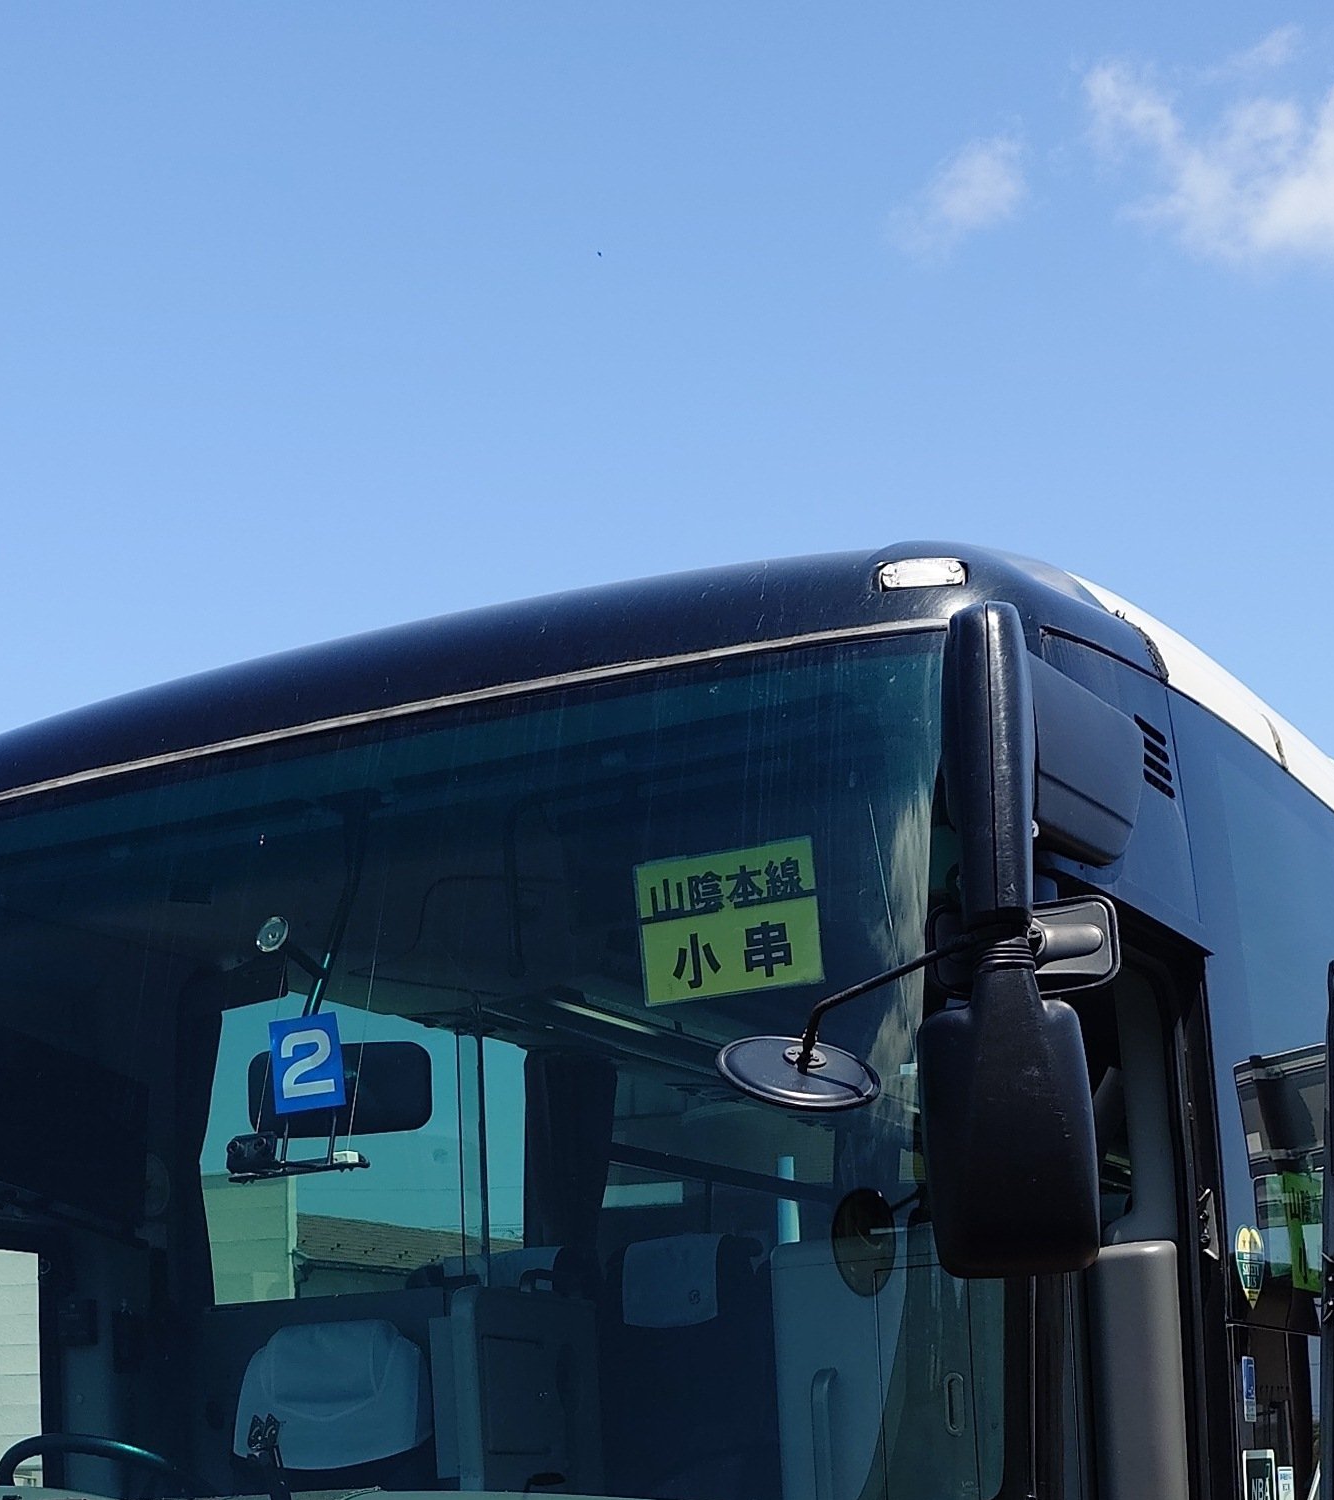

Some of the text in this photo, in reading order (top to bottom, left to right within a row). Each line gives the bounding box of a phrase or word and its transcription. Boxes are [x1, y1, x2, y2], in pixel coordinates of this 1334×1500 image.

[650, 857, 805, 919] 山陰本線
[672, 921, 793, 990] 小串
[280, 1028, 336, 1099] 2
